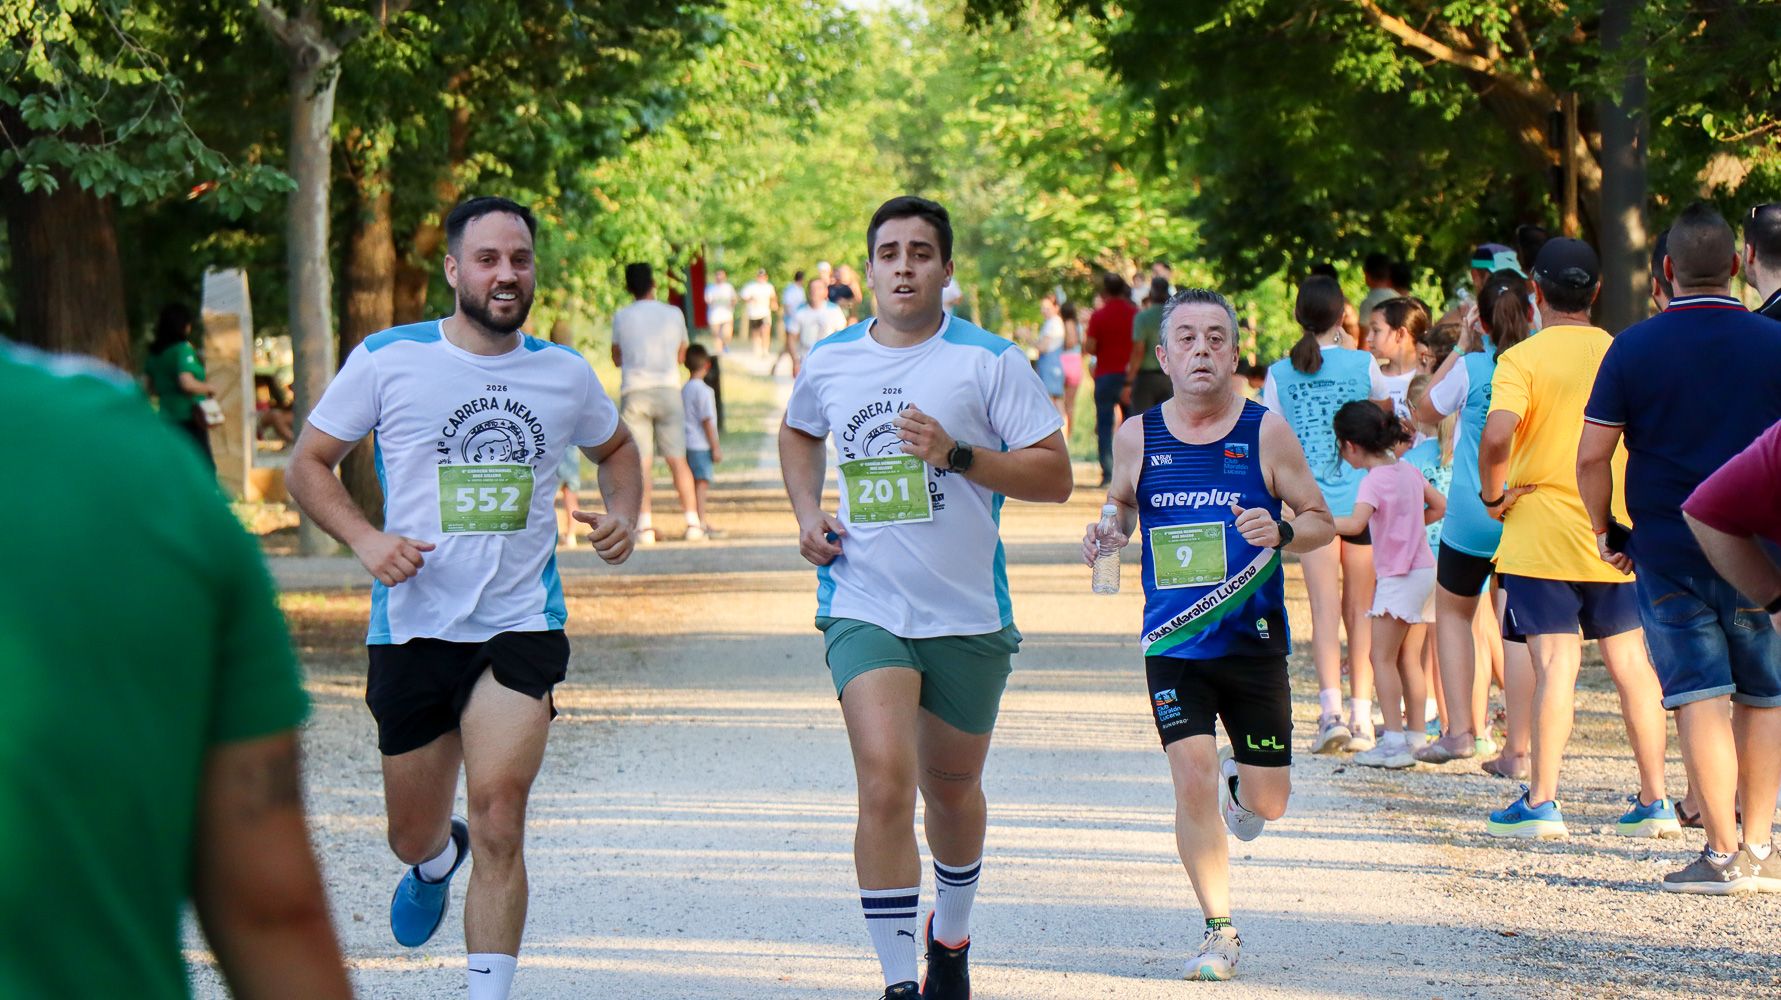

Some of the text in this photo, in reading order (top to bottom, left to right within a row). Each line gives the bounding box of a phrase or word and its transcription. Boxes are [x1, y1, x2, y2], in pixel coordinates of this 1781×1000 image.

[486, 384, 508, 392] 2026
[882, 387, 903, 395] 2026
[442, 396, 500, 438] CARRERA
[843, 400, 893, 442] CARRERA
[456, 486, 520, 513] 552
[858, 477, 910, 504] 201
[1150, 488, 1241, 509] enerplus
[1176, 545, 1193, 568] 9
[1147, 565, 1257, 643] Club Maratón Lucena
